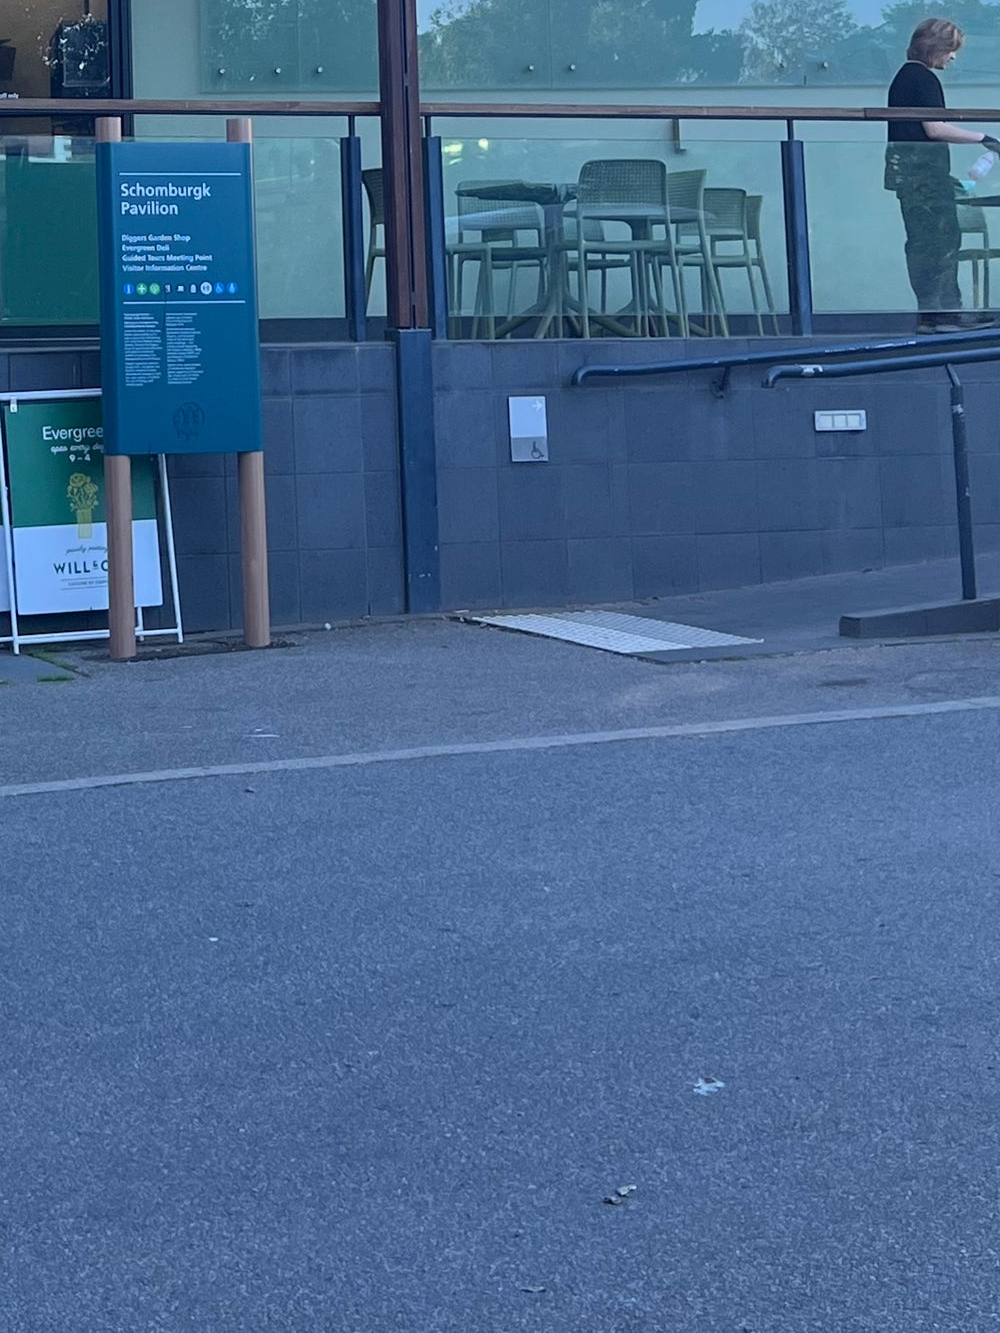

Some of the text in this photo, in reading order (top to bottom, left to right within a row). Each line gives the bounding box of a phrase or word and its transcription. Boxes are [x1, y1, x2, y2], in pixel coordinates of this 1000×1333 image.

[120, 182, 211, 200] Schomburgk
[120, 201, 179, 215] Pavilion
[121, 234, 191, 243] Diggers Garden Shop
[121, 244, 155, 253] Evergreen
[121, 254, 213, 263] Guided Tours Meeting Point
[122, 264, 208, 272] Visitor Information Centre
[42, 425, 104, 443] Evergree
